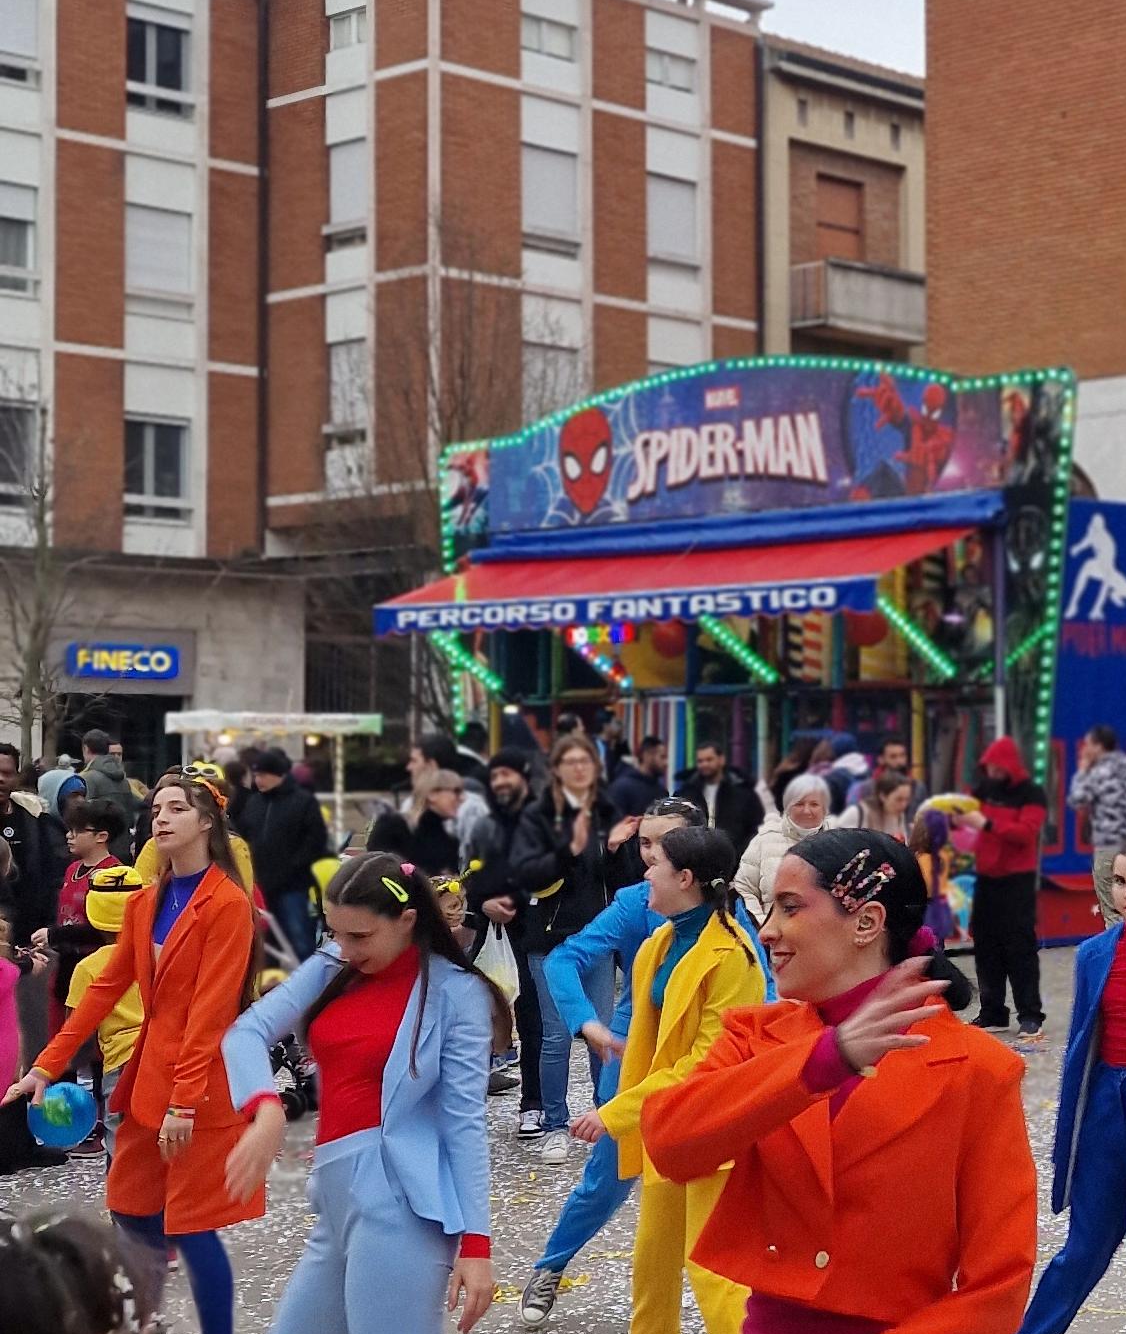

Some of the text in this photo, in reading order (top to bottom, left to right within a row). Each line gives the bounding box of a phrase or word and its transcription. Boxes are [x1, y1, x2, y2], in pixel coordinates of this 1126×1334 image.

[397, 586, 836, 629] PERCORSO FANTASTICO
[77, 648, 171, 672] FINECO
